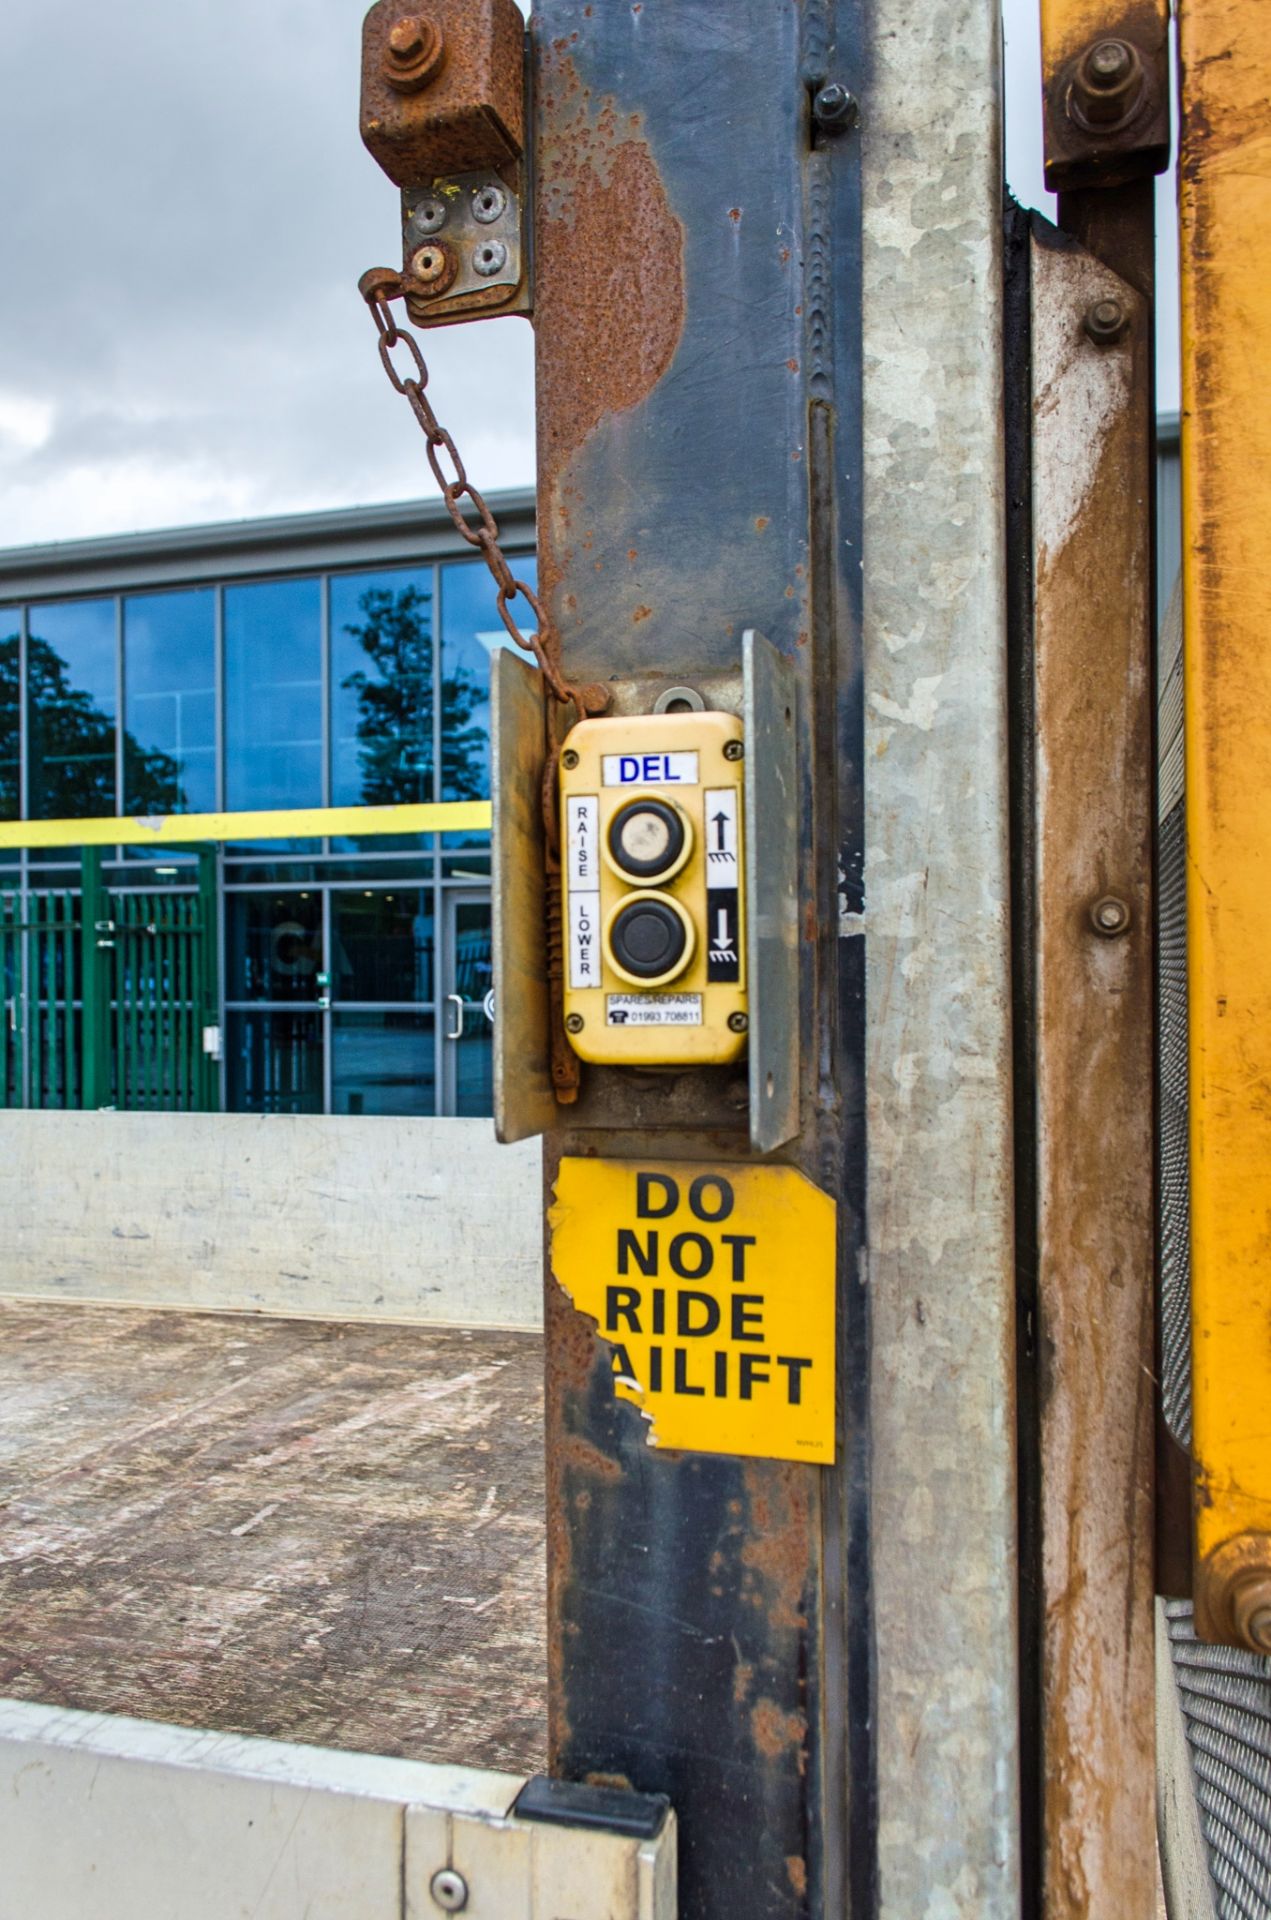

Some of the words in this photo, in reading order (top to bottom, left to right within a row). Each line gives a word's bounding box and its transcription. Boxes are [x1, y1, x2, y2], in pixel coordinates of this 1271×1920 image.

[619, 756, 681, 782] DEL
[577, 807, 588, 877] RAISE
[578, 905, 592, 974] LOWER
[631, 1011, 661, 1022] 01993
[636, 1172, 735, 1223] DO
[617, 1229, 756, 1282] NOT
[605, 1285, 765, 1343] RIDE
[609, 1343, 812, 1406] AILIFT
